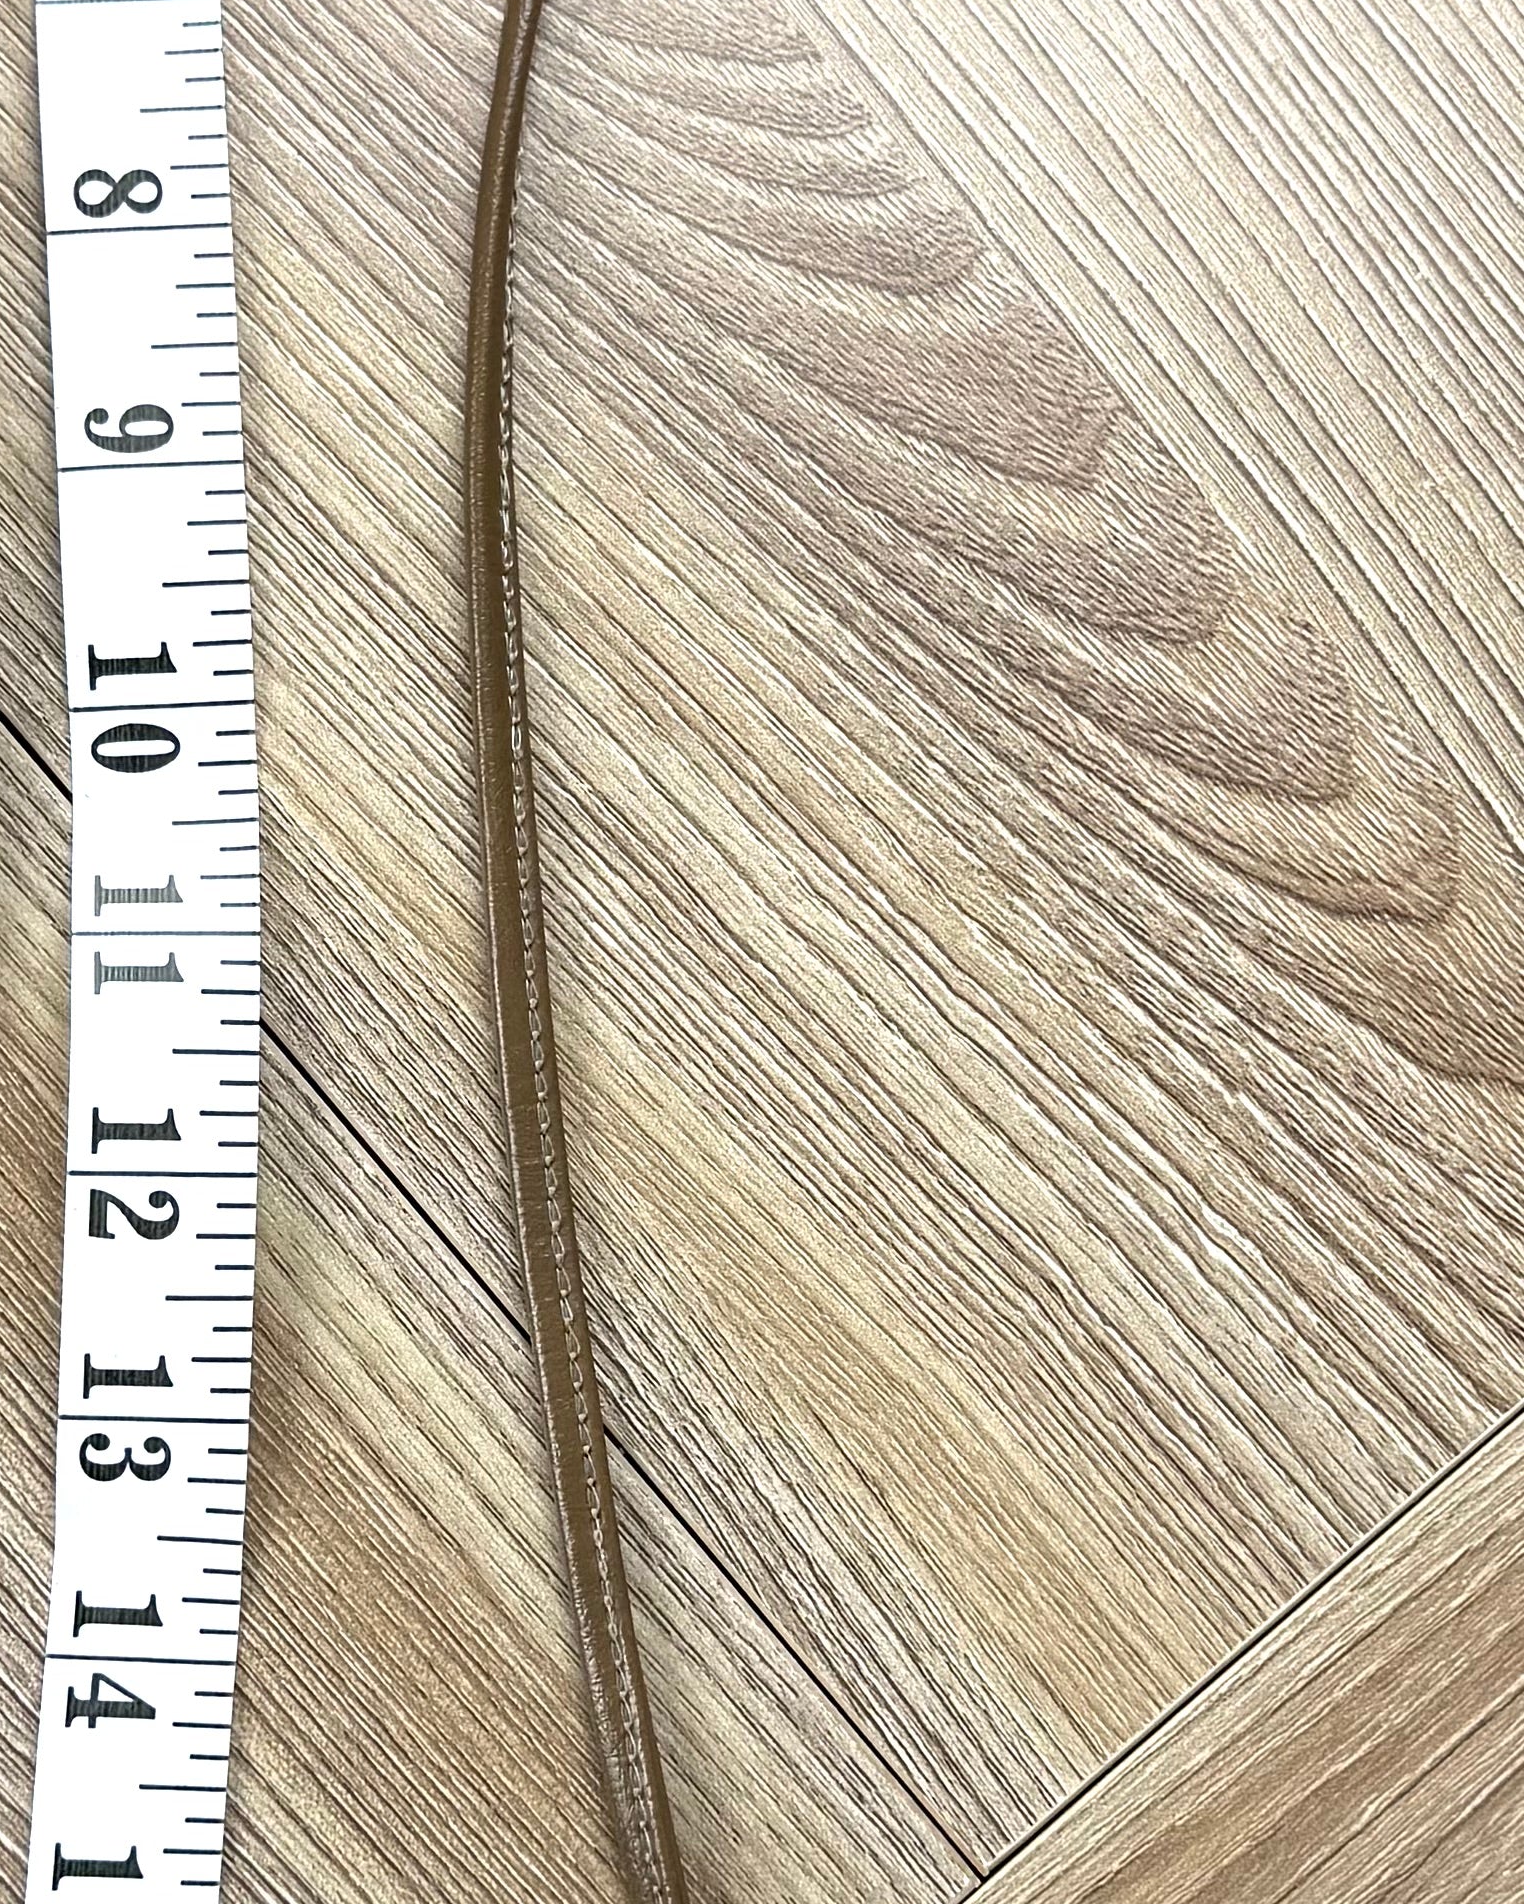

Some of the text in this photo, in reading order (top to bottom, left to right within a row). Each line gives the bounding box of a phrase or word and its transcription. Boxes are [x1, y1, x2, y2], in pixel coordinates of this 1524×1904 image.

[73, 169, 162, 218] 8
[84, 403, 174, 453] 9
[88, 641, 180, 773] 10
[94, 875, 183, 994] 11
[88, 1107, 181, 1241] 12
[79, 1353, 173, 1482] 13
[65, 1590, 163, 1728] 14
